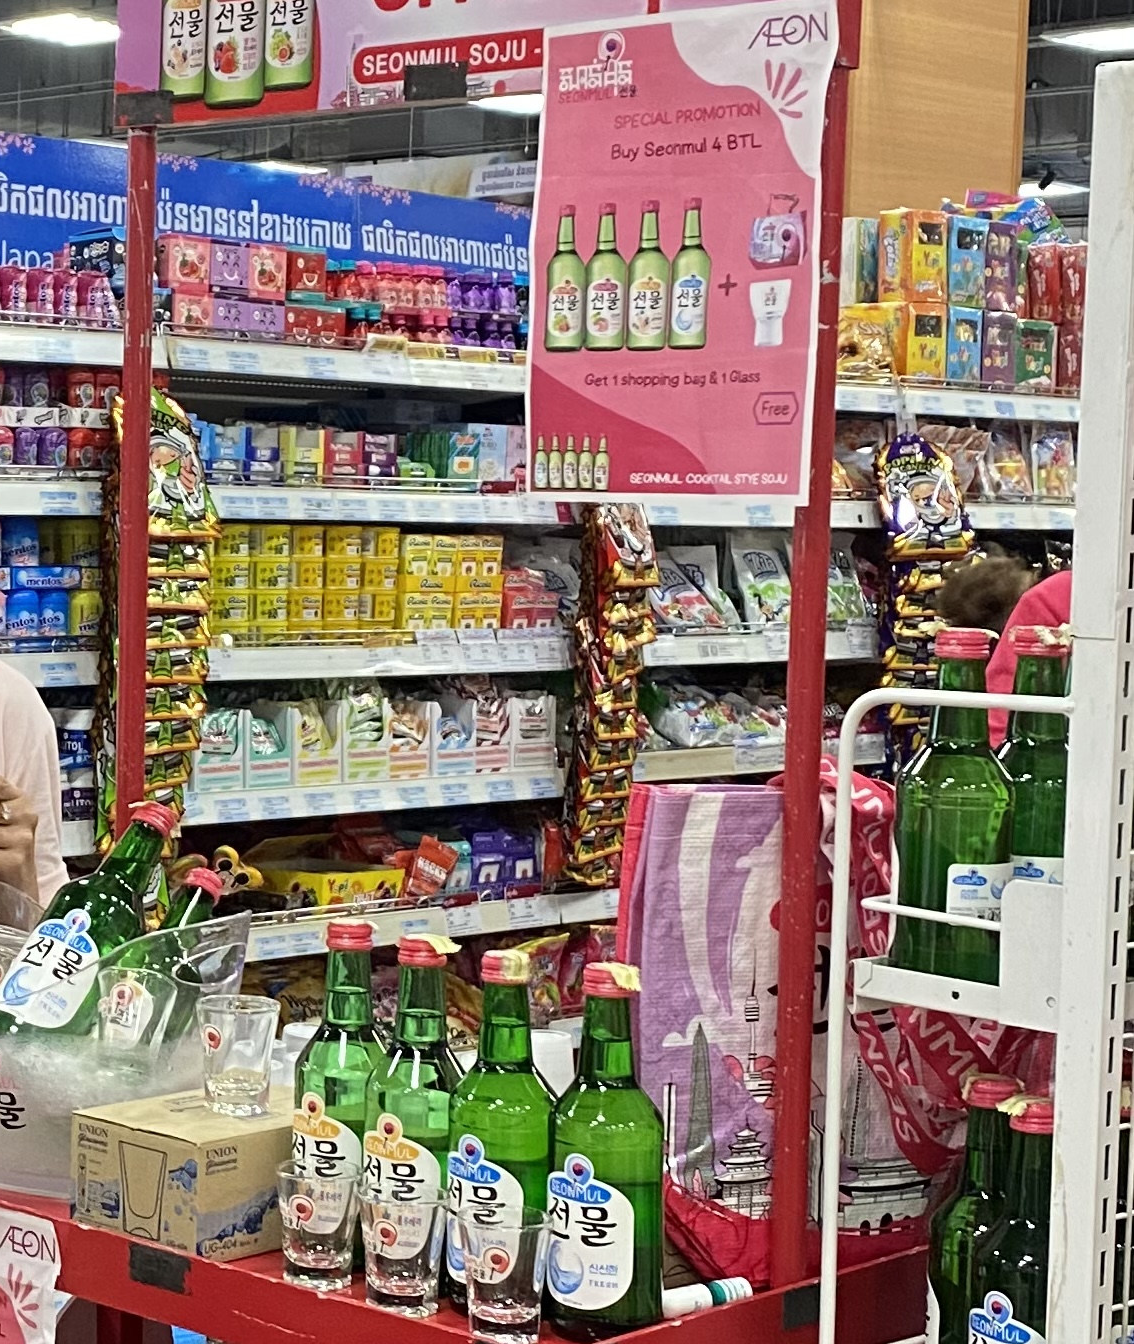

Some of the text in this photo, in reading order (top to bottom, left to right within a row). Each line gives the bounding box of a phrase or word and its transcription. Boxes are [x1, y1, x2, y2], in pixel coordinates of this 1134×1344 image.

[469, 39, 526, 67] SOJU
[614, 100, 762, 130] SPECIAL PROMOTION
[610, 133, 763, 162] Buy Seonmul 4 BTL
[584, 373, 609, 387] Get
[621, 372, 680, 388] shopping
[683, 372, 706, 388] bag
[709, 371, 719, 385] &
[729, 369, 761, 384] Glass
[761, 400, 790, 416] Free
[629, 472, 683, 485] SEONMUL
[761, 472, 788, 485] SOJU
[41, 923, 88, 952] SEONUL
[78, 1123, 110, 1138] UNION
[205, 1145, 239, 1159] UNION
[551, 1178, 607, 1204] SEONMUL
[549, 1196, 618, 1248] 선물
